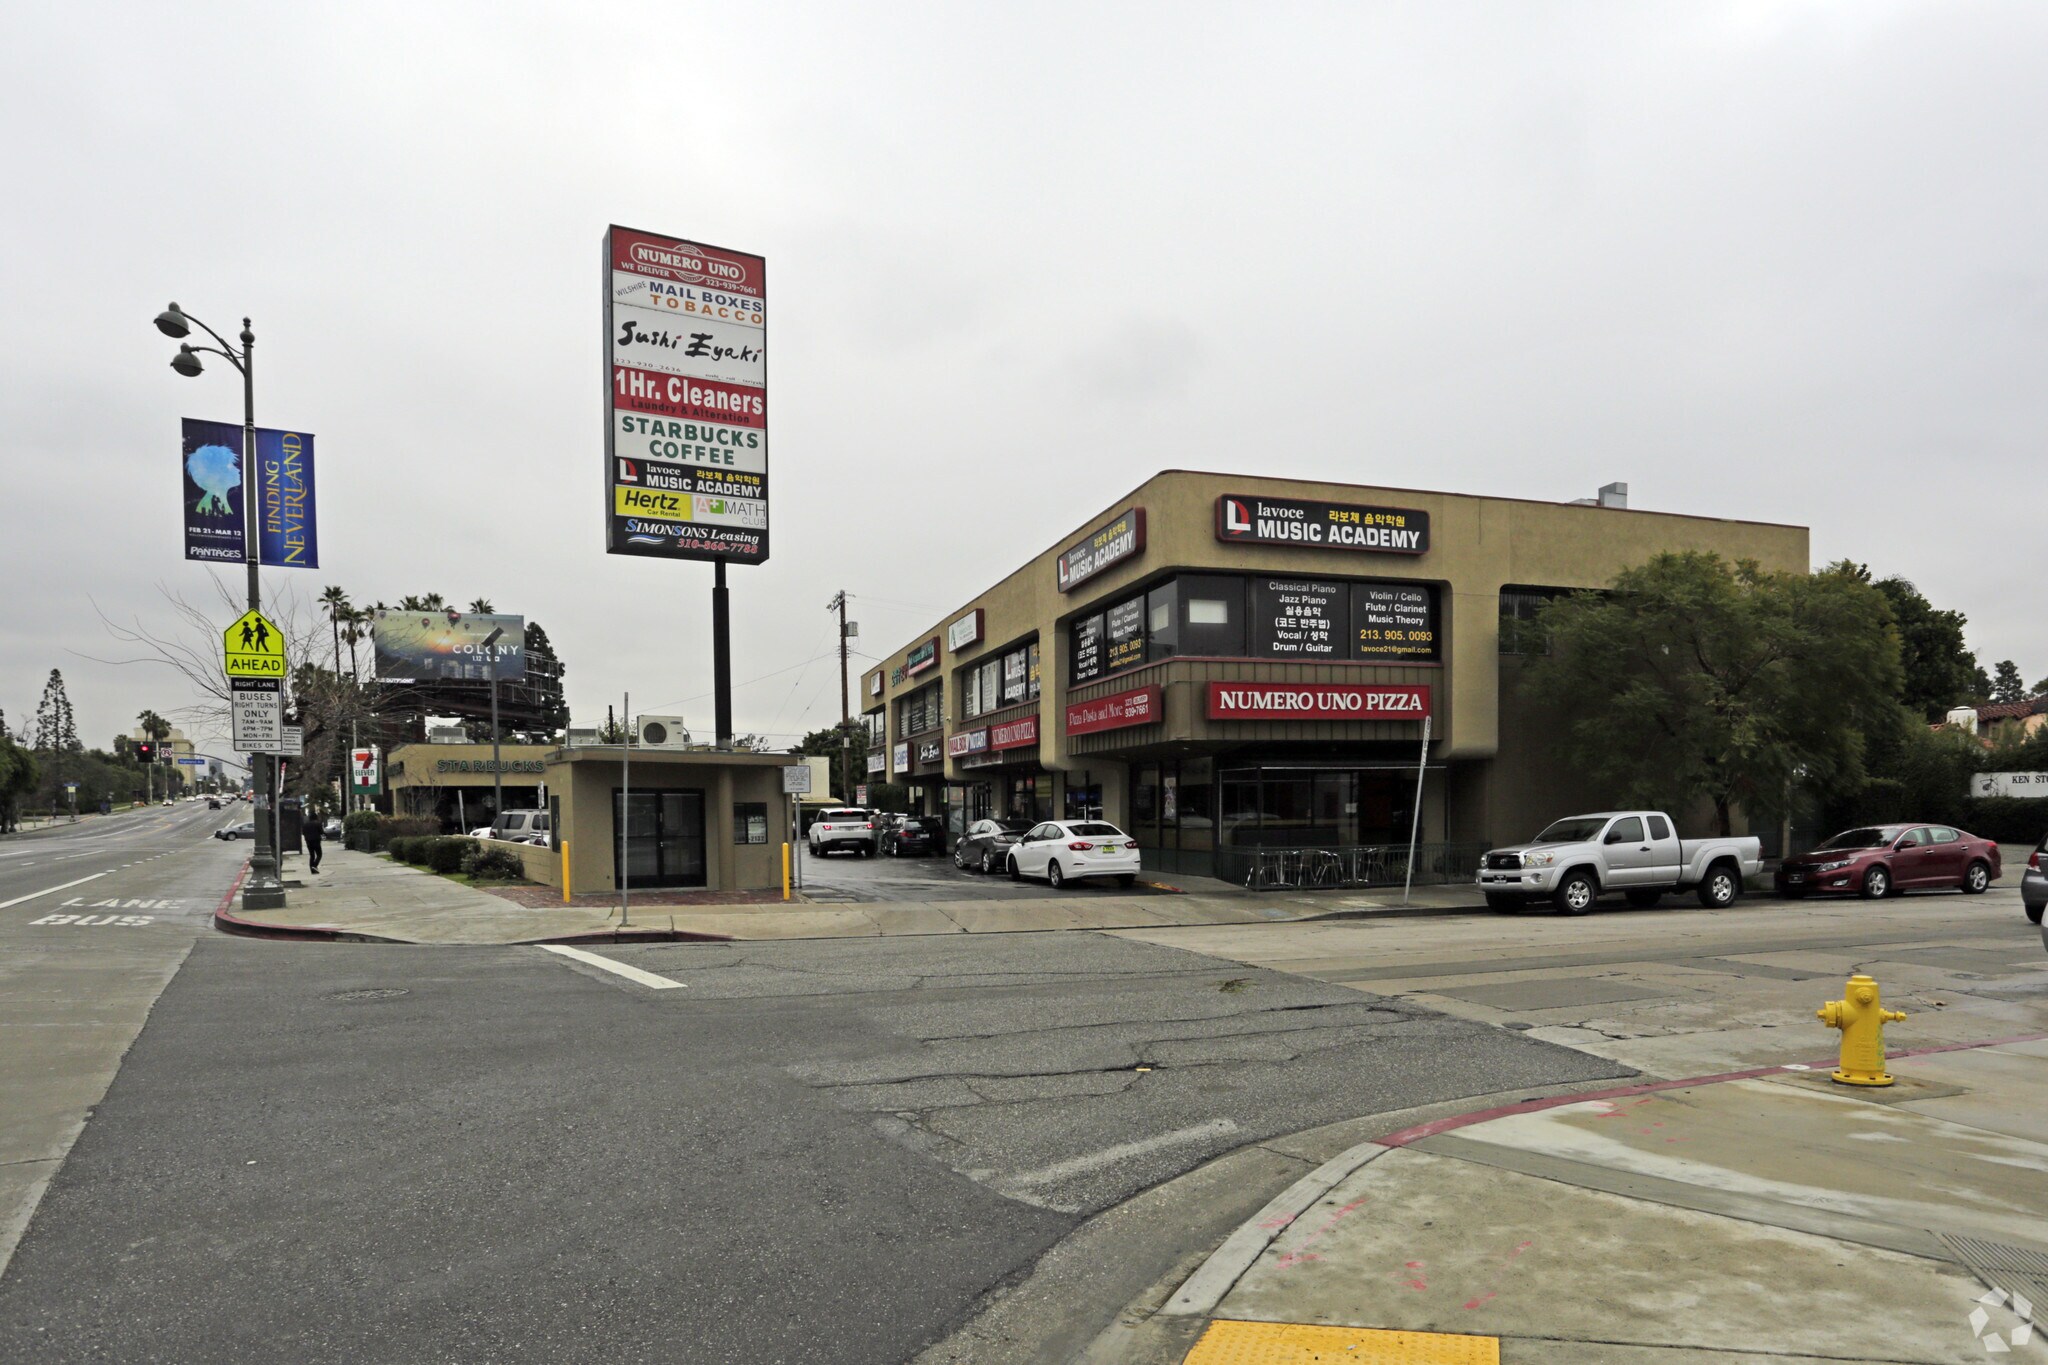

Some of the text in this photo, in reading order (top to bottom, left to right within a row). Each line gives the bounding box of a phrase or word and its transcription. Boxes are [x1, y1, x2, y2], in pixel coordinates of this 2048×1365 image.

[621, 261, 634, 271] WE
[638, 265, 670, 278] DELIVER
[638, 247, 702, 271] NUMERO
[708, 262, 740, 279] UNO
[615, 280, 646, 296] WILSHIRE
[650, 281, 762, 312] MAIL BOXES
[650, 294, 763, 324] TOBACCO
[618, 320, 682, 350] Sushi
[616, 369, 763, 415] 1Hr. Cleaners
[632, 398, 749, 424] Laundry & Alteration
[622, 416, 758, 448] STARBUCKS
[650, 440, 734, 465] COFFEE
[646, 463, 680, 476] lavoce
[646, 474, 761, 498] MUSIC ACADEMY
[265, 460, 282, 533] FINDING
[282, 433, 308, 565] NEVERLAND
[625, 490, 680, 511] Hertz
[724, 500, 766, 517] MATH
[1258, 502, 1304, 520] lavoce
[742, 516, 766, 526] CLUB
[1328, 510, 1406, 528] 라보체 음악학원
[711, 531, 759, 545] Leasing
[1258, 518, 1420, 549] MUSIC ACADEMY
[190, 546, 242, 558] PANTAGES
[1068, 548, 1086, 564] lavoce
[1069, 530, 1133, 583] MUSIC ACADEMY
[1269, 582, 1336, 594] Classical Piano
[1279, 595, 1326, 605] Jazz Piano
[1370, 591, 1393, 600] Violin
[1400, 592, 1422, 602] Cello
[1285, 606, 1322, 616] 실용음악
[1366, 603, 1386, 612] Flute
[1394, 604, 1426, 614] Clarinet
[1275, 618, 1297, 628] (코드
[1368, 614, 1424, 626] Music Theory
[1278, 631, 1302, 640] Vocal
[1310, 631, 1328, 641] 성악
[1360, 630, 1432, 642] 213. 905. 0093
[1273, 642, 1297, 652] Drum
[1306, 644, 1332, 652] Guitar
[1361, 645, 1432, 654] lavoce21@gmail.com
[230, 658, 280, 671] AHEAD
[240, 692, 272, 700] BUSES
[1220, 691, 1422, 710] NUMERO UNO PIZZA
[1069, 703, 1123, 726] Pizza Pasta and More
[992, 728, 1010, 746] NUMERO
[1020, 721, 1035, 740] PIZZA
[437, 759, 546, 773] STARBUCKS
[2012, 776, 2030, 784] KEN
[60, 897, 187, 909] LANE
[28, 914, 154, 926] BUS
